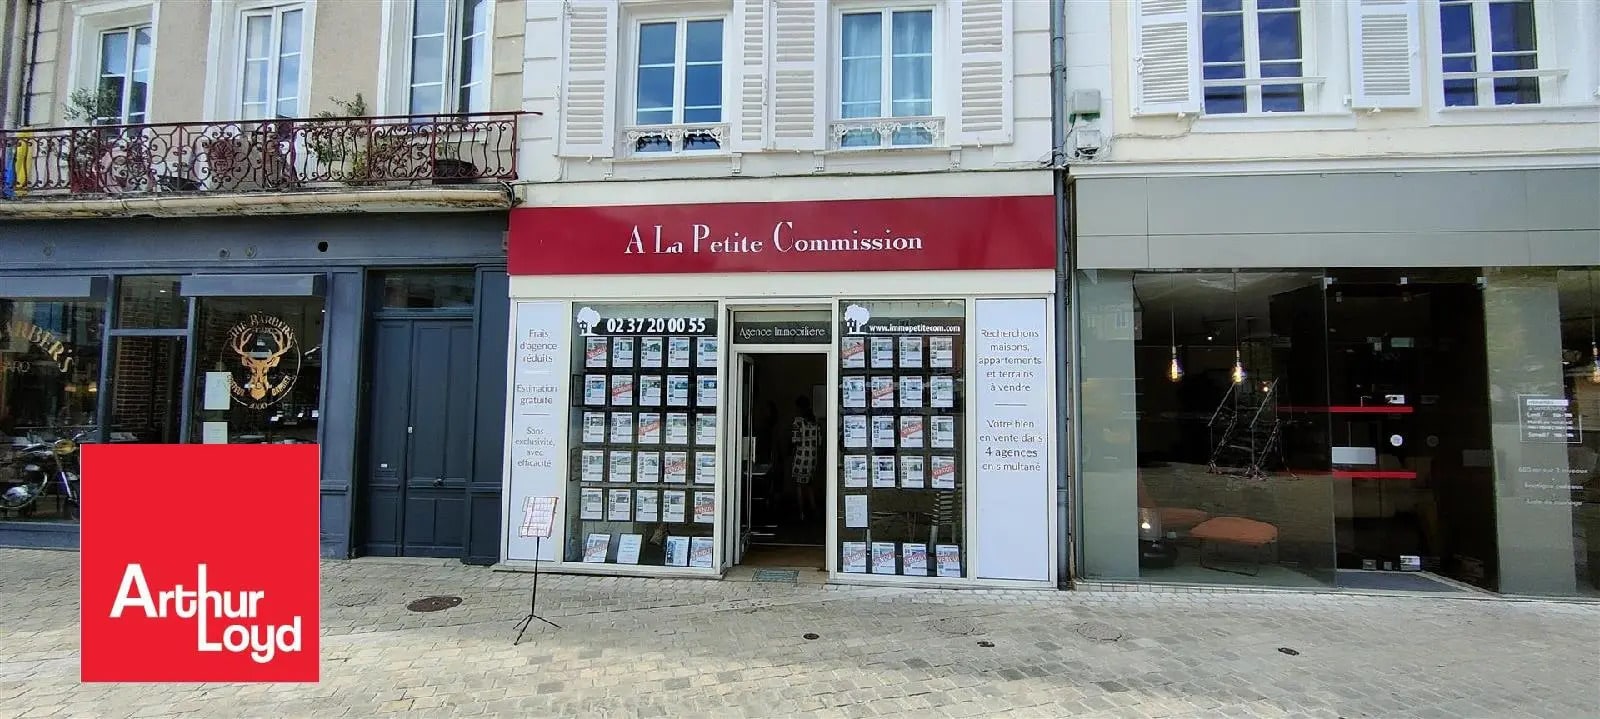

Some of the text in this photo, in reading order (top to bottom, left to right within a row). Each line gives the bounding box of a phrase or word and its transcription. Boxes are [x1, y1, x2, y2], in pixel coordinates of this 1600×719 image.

[624, 221, 923, 254] A La Petite Commission
[606, 317, 706, 333] 02 37 20 00 55
[529, 329, 549, 338] Frais
[739, 327, 773, 339] Agence
[981, 329, 1039, 338] Recherchons
[520, 341, 558, 352] d'agence
[990, 342, 1030, 352] maisons,
[978, 357, 1042, 366] appartements
[986, 370, 996, 378] et
[990, 382, 1031, 391] à vendre
[520, 396, 553, 405] gratuite
[986, 419, 1013, 428] Votre
[526, 426, 544, 435] Sans
[993, 434, 1019, 442] vente
[985, 447, 1038, 458] 4 agences
[996, 462, 1041, 471] smultané
